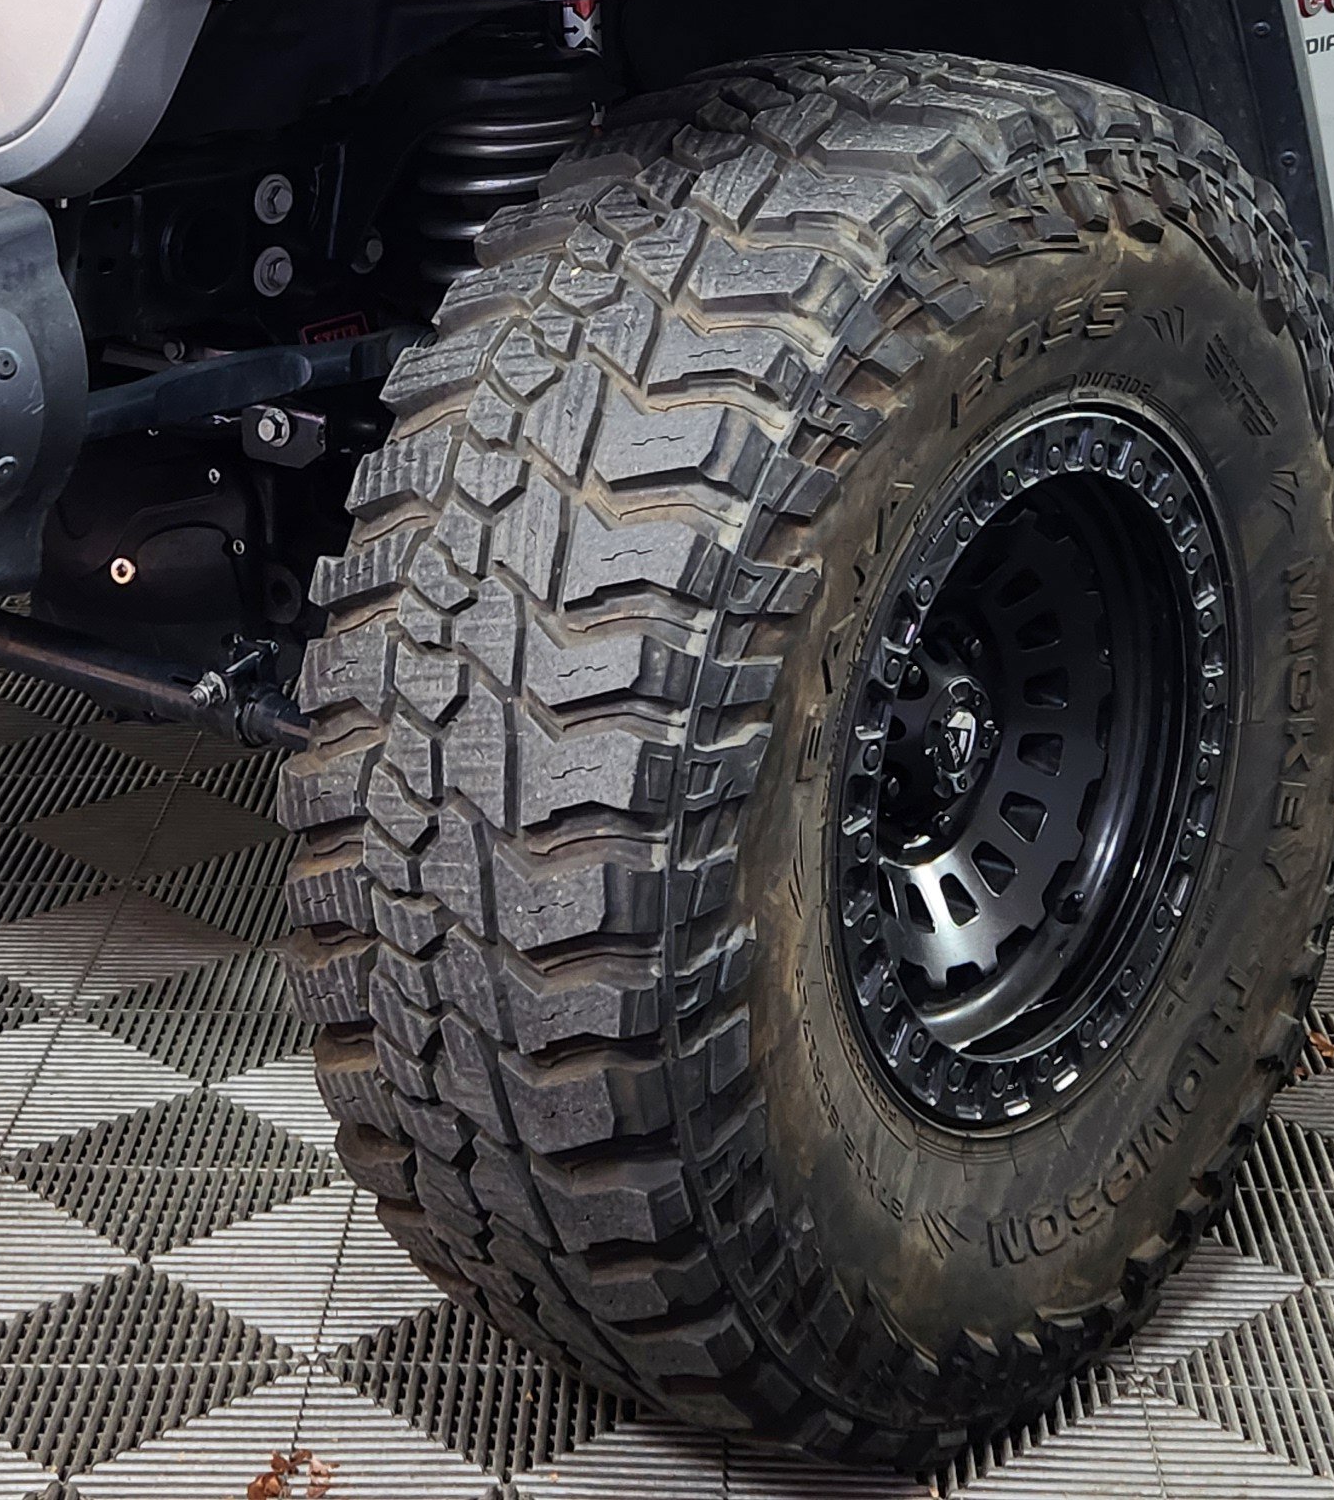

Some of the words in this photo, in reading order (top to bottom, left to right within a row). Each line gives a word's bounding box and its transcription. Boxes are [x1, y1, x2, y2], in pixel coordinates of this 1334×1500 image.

[949, 289, 1135, 428] BOSS
[1077, 371, 1153, 400] OUTSIDE
[944, 730, 961, 769] FUEL
[1264, 560, 1322, 891] MICKEY
[986, 960, 1265, 1269] THOMPSON
